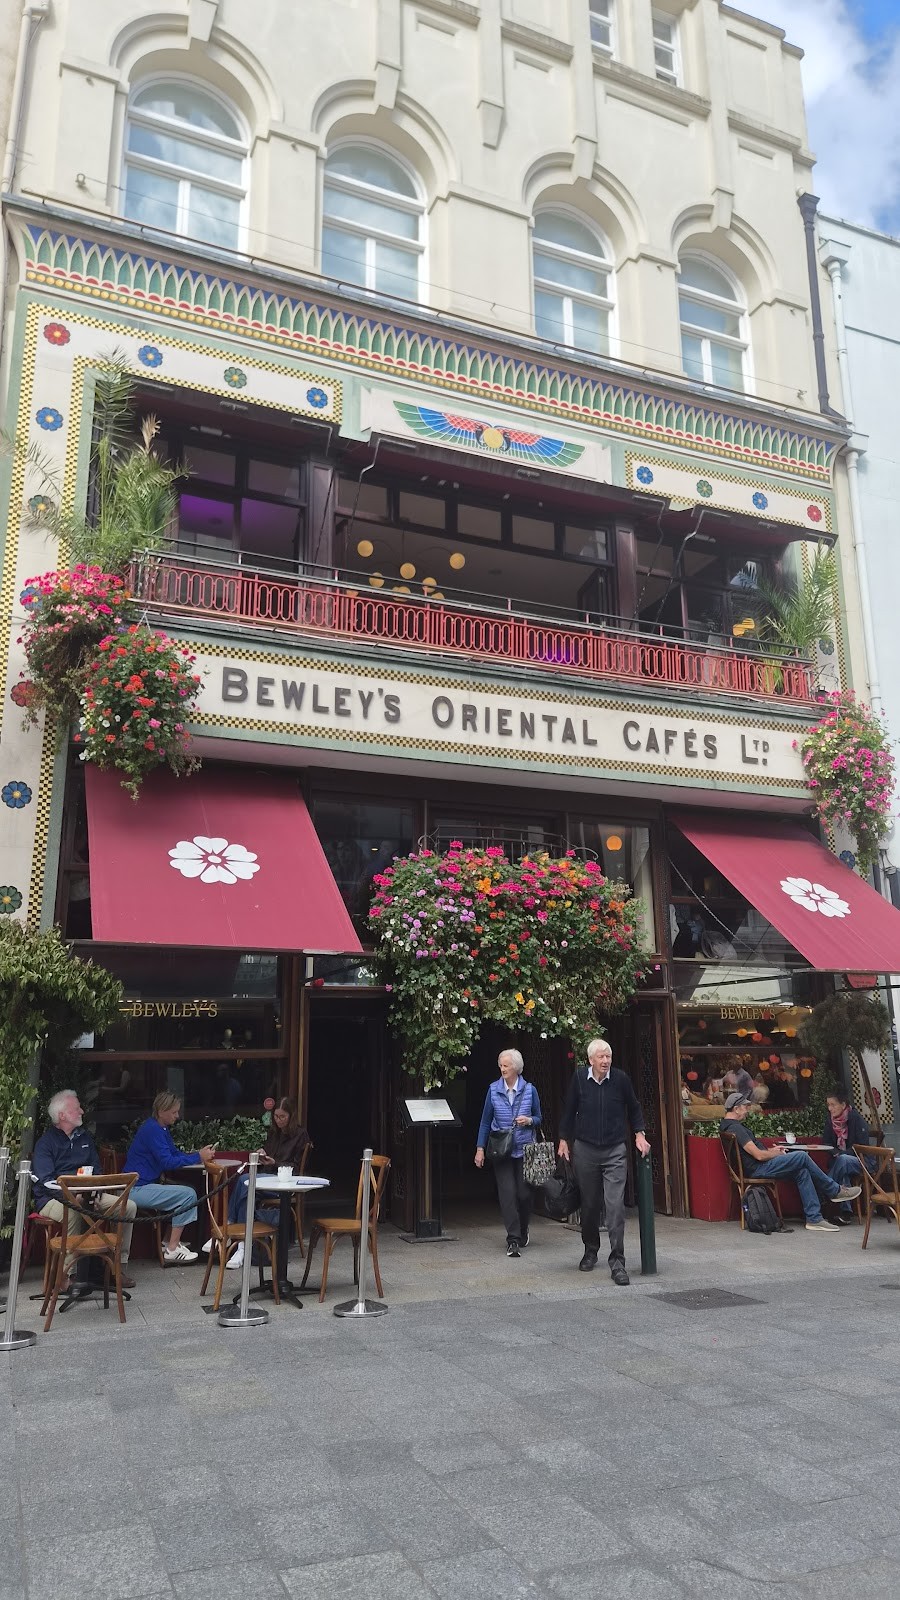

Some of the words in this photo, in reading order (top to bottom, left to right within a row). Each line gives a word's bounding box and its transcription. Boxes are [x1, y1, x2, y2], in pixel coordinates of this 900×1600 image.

[222, 666, 401, 724] BEWLEY'S
[431, 695, 598, 747] ORIENTAL
[623, 720, 718, 760] CAFÉS
[131, 1002, 218, 1018] BEWLEY'S
[720, 1007, 776, 1020] BEWLEY'S
